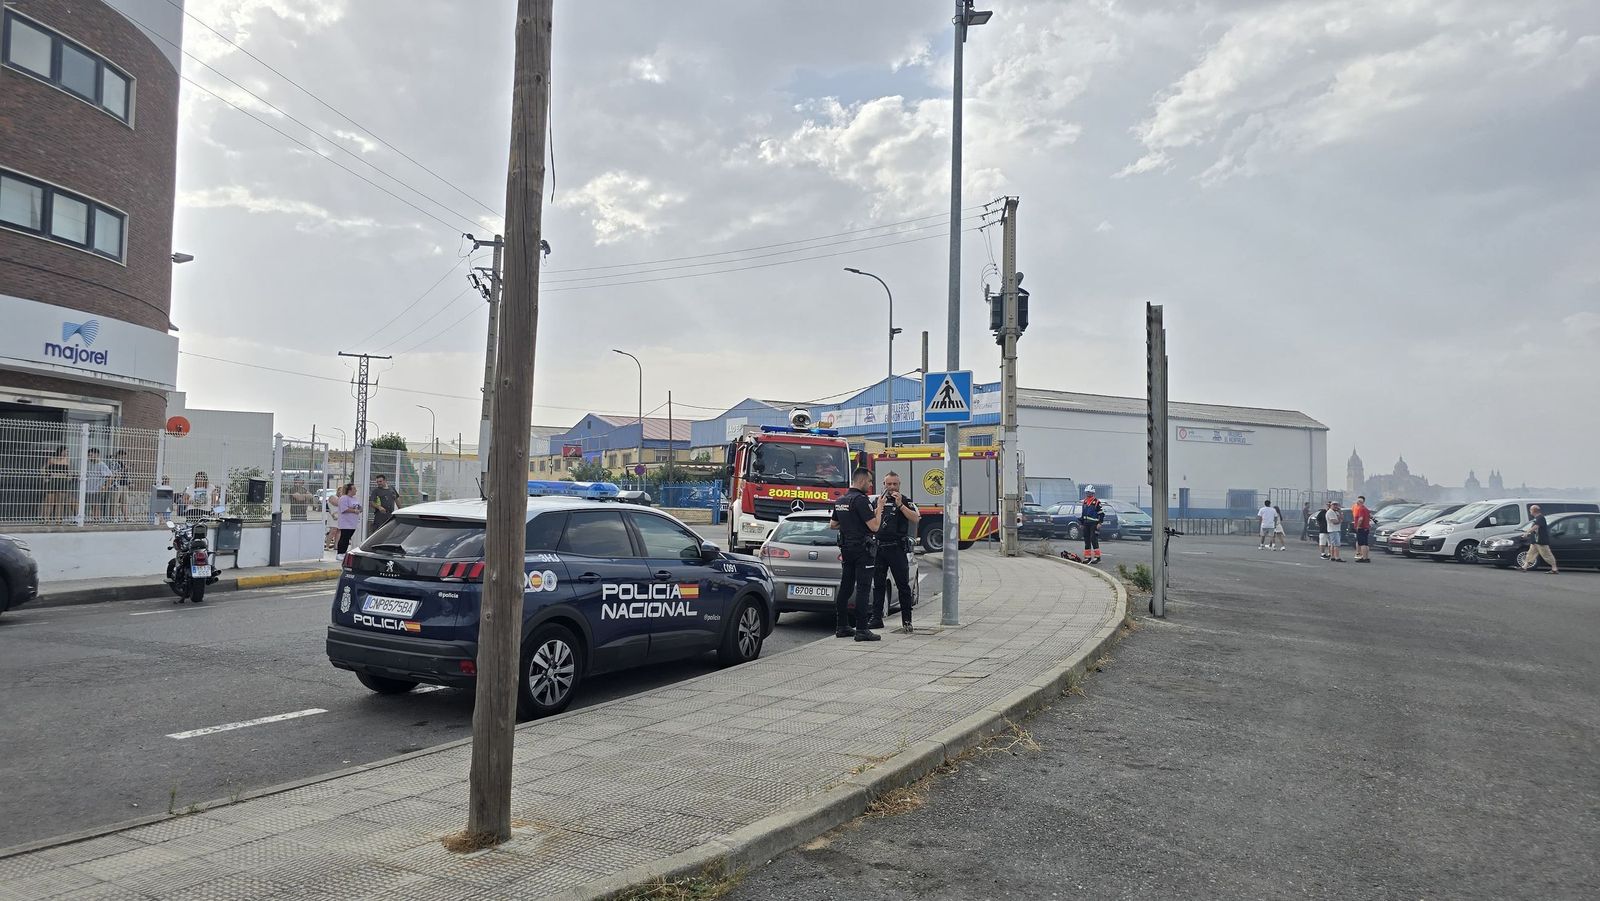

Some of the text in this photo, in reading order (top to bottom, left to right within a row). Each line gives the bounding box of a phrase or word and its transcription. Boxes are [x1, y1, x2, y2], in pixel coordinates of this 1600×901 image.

[44, 342, 108, 365] majorel
[795, 586, 830, 596] 6708 CDL
[368, 596, 414, 615] CNP8575BA
[601, 601, 698, 619] NACIONAL
